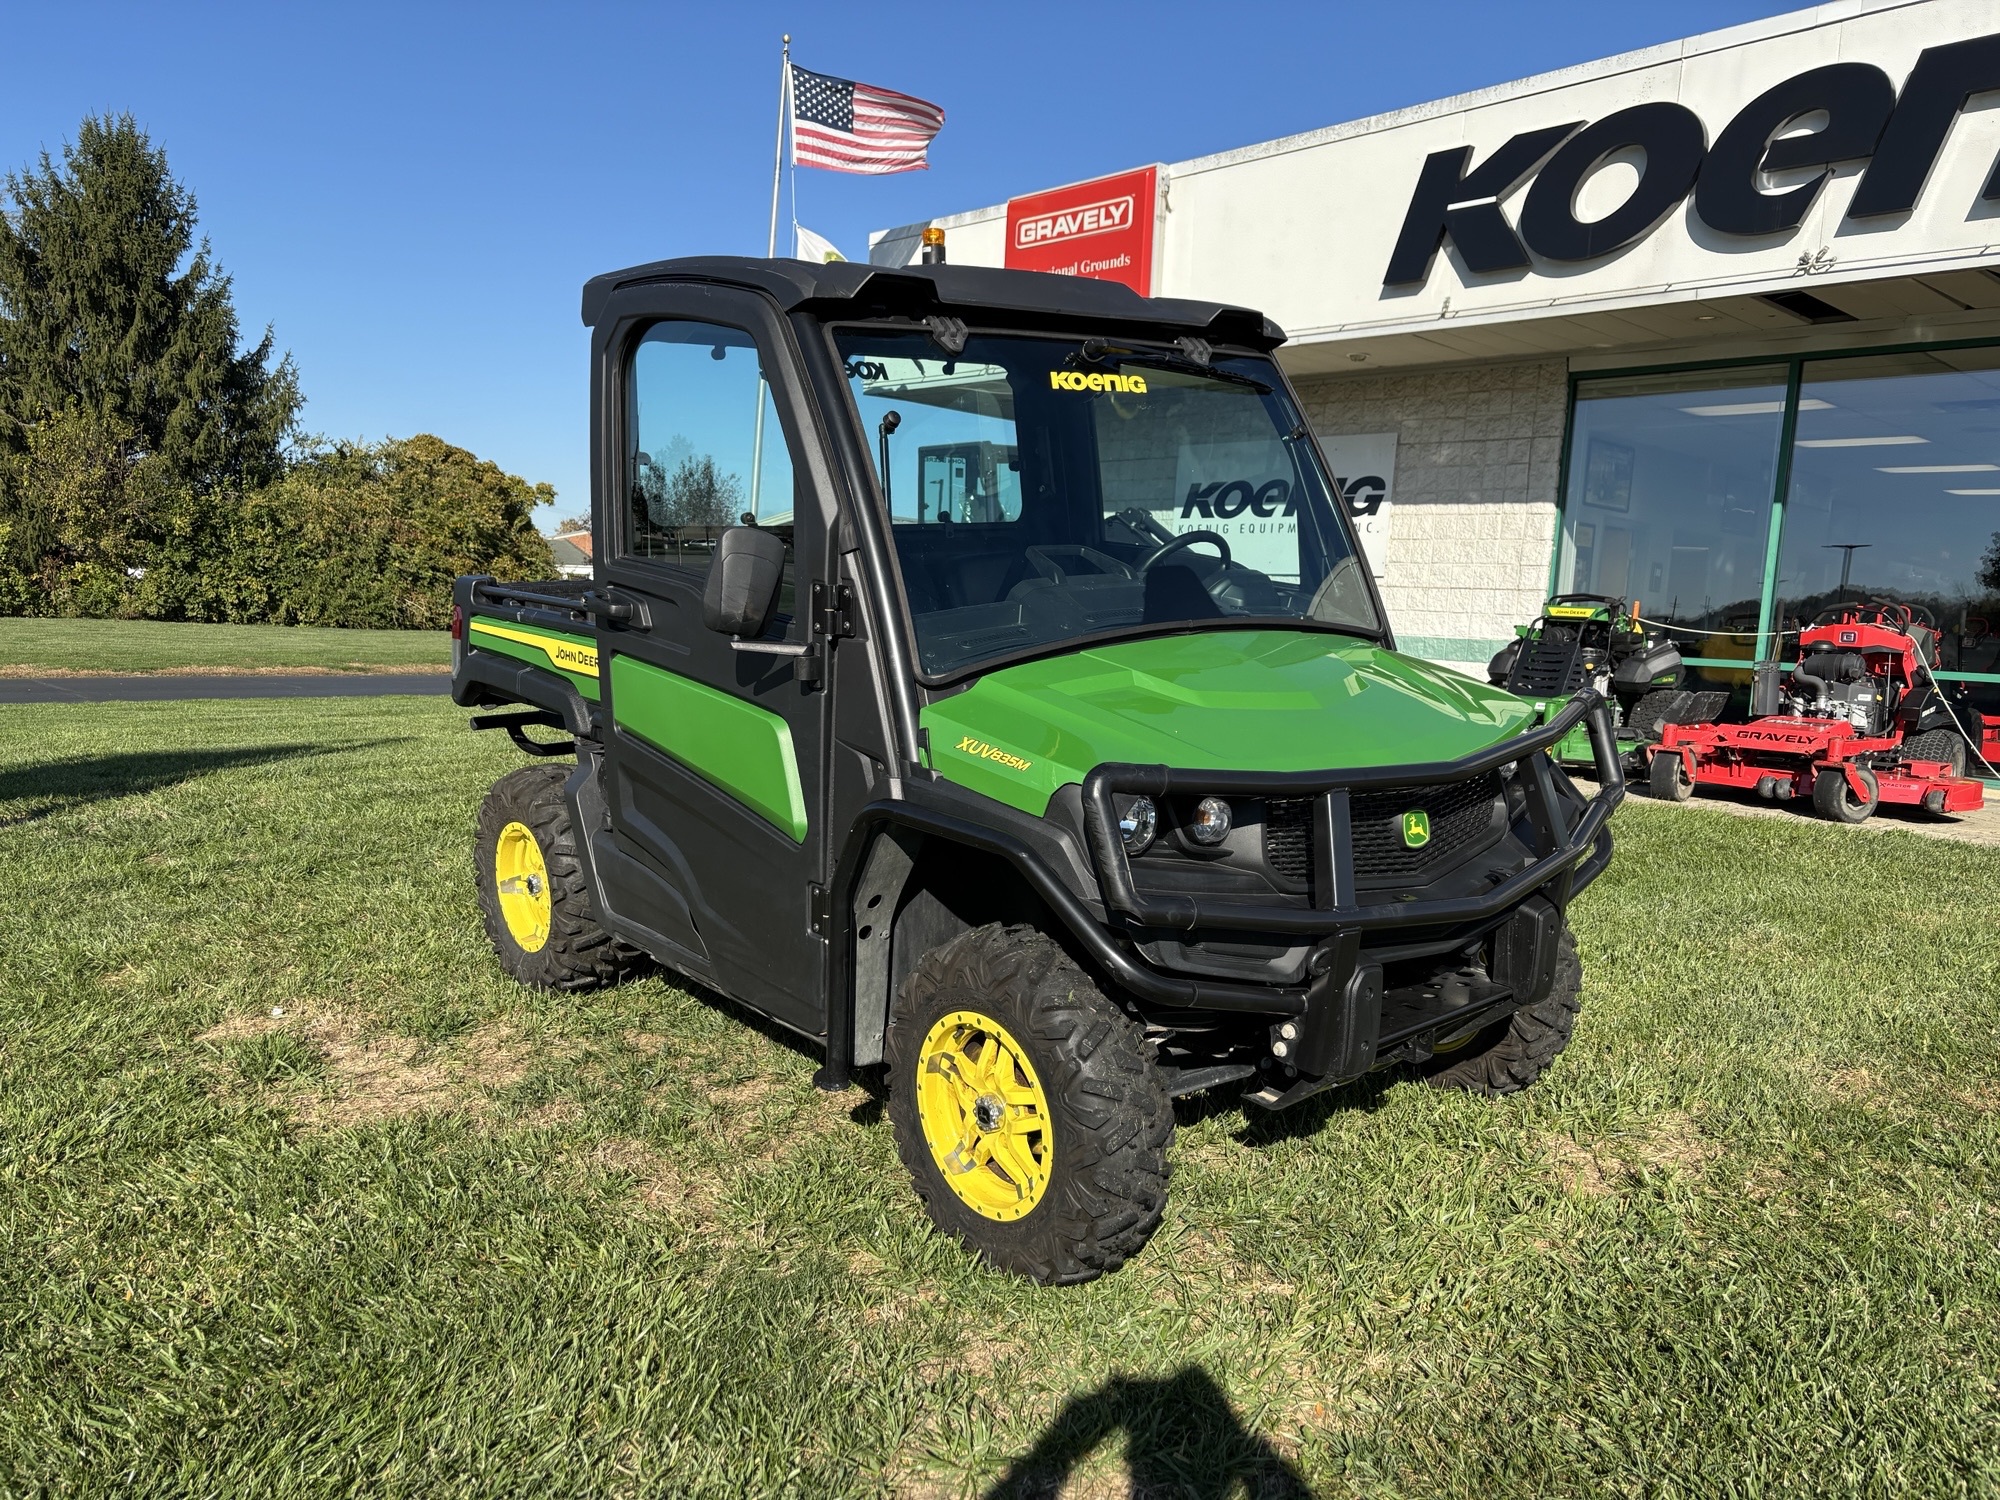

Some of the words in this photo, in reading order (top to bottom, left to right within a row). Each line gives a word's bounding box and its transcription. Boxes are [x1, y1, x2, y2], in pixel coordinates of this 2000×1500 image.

[1020, 202, 1127, 243] GRAVELY
[1080, 253, 1131, 273] Grounds
[1180, 475, 1386, 519] KOeG
[1239, 523, 1297, 534] EQUIPM
[1353, 522, 1379, 533] NC.
[556, 646, 577, 663] JOHN
[578, 651, 599, 668] DEER
[1736, 730, 1819, 745] GRAVELY
[954, 736, 1034, 772] XUV835M
